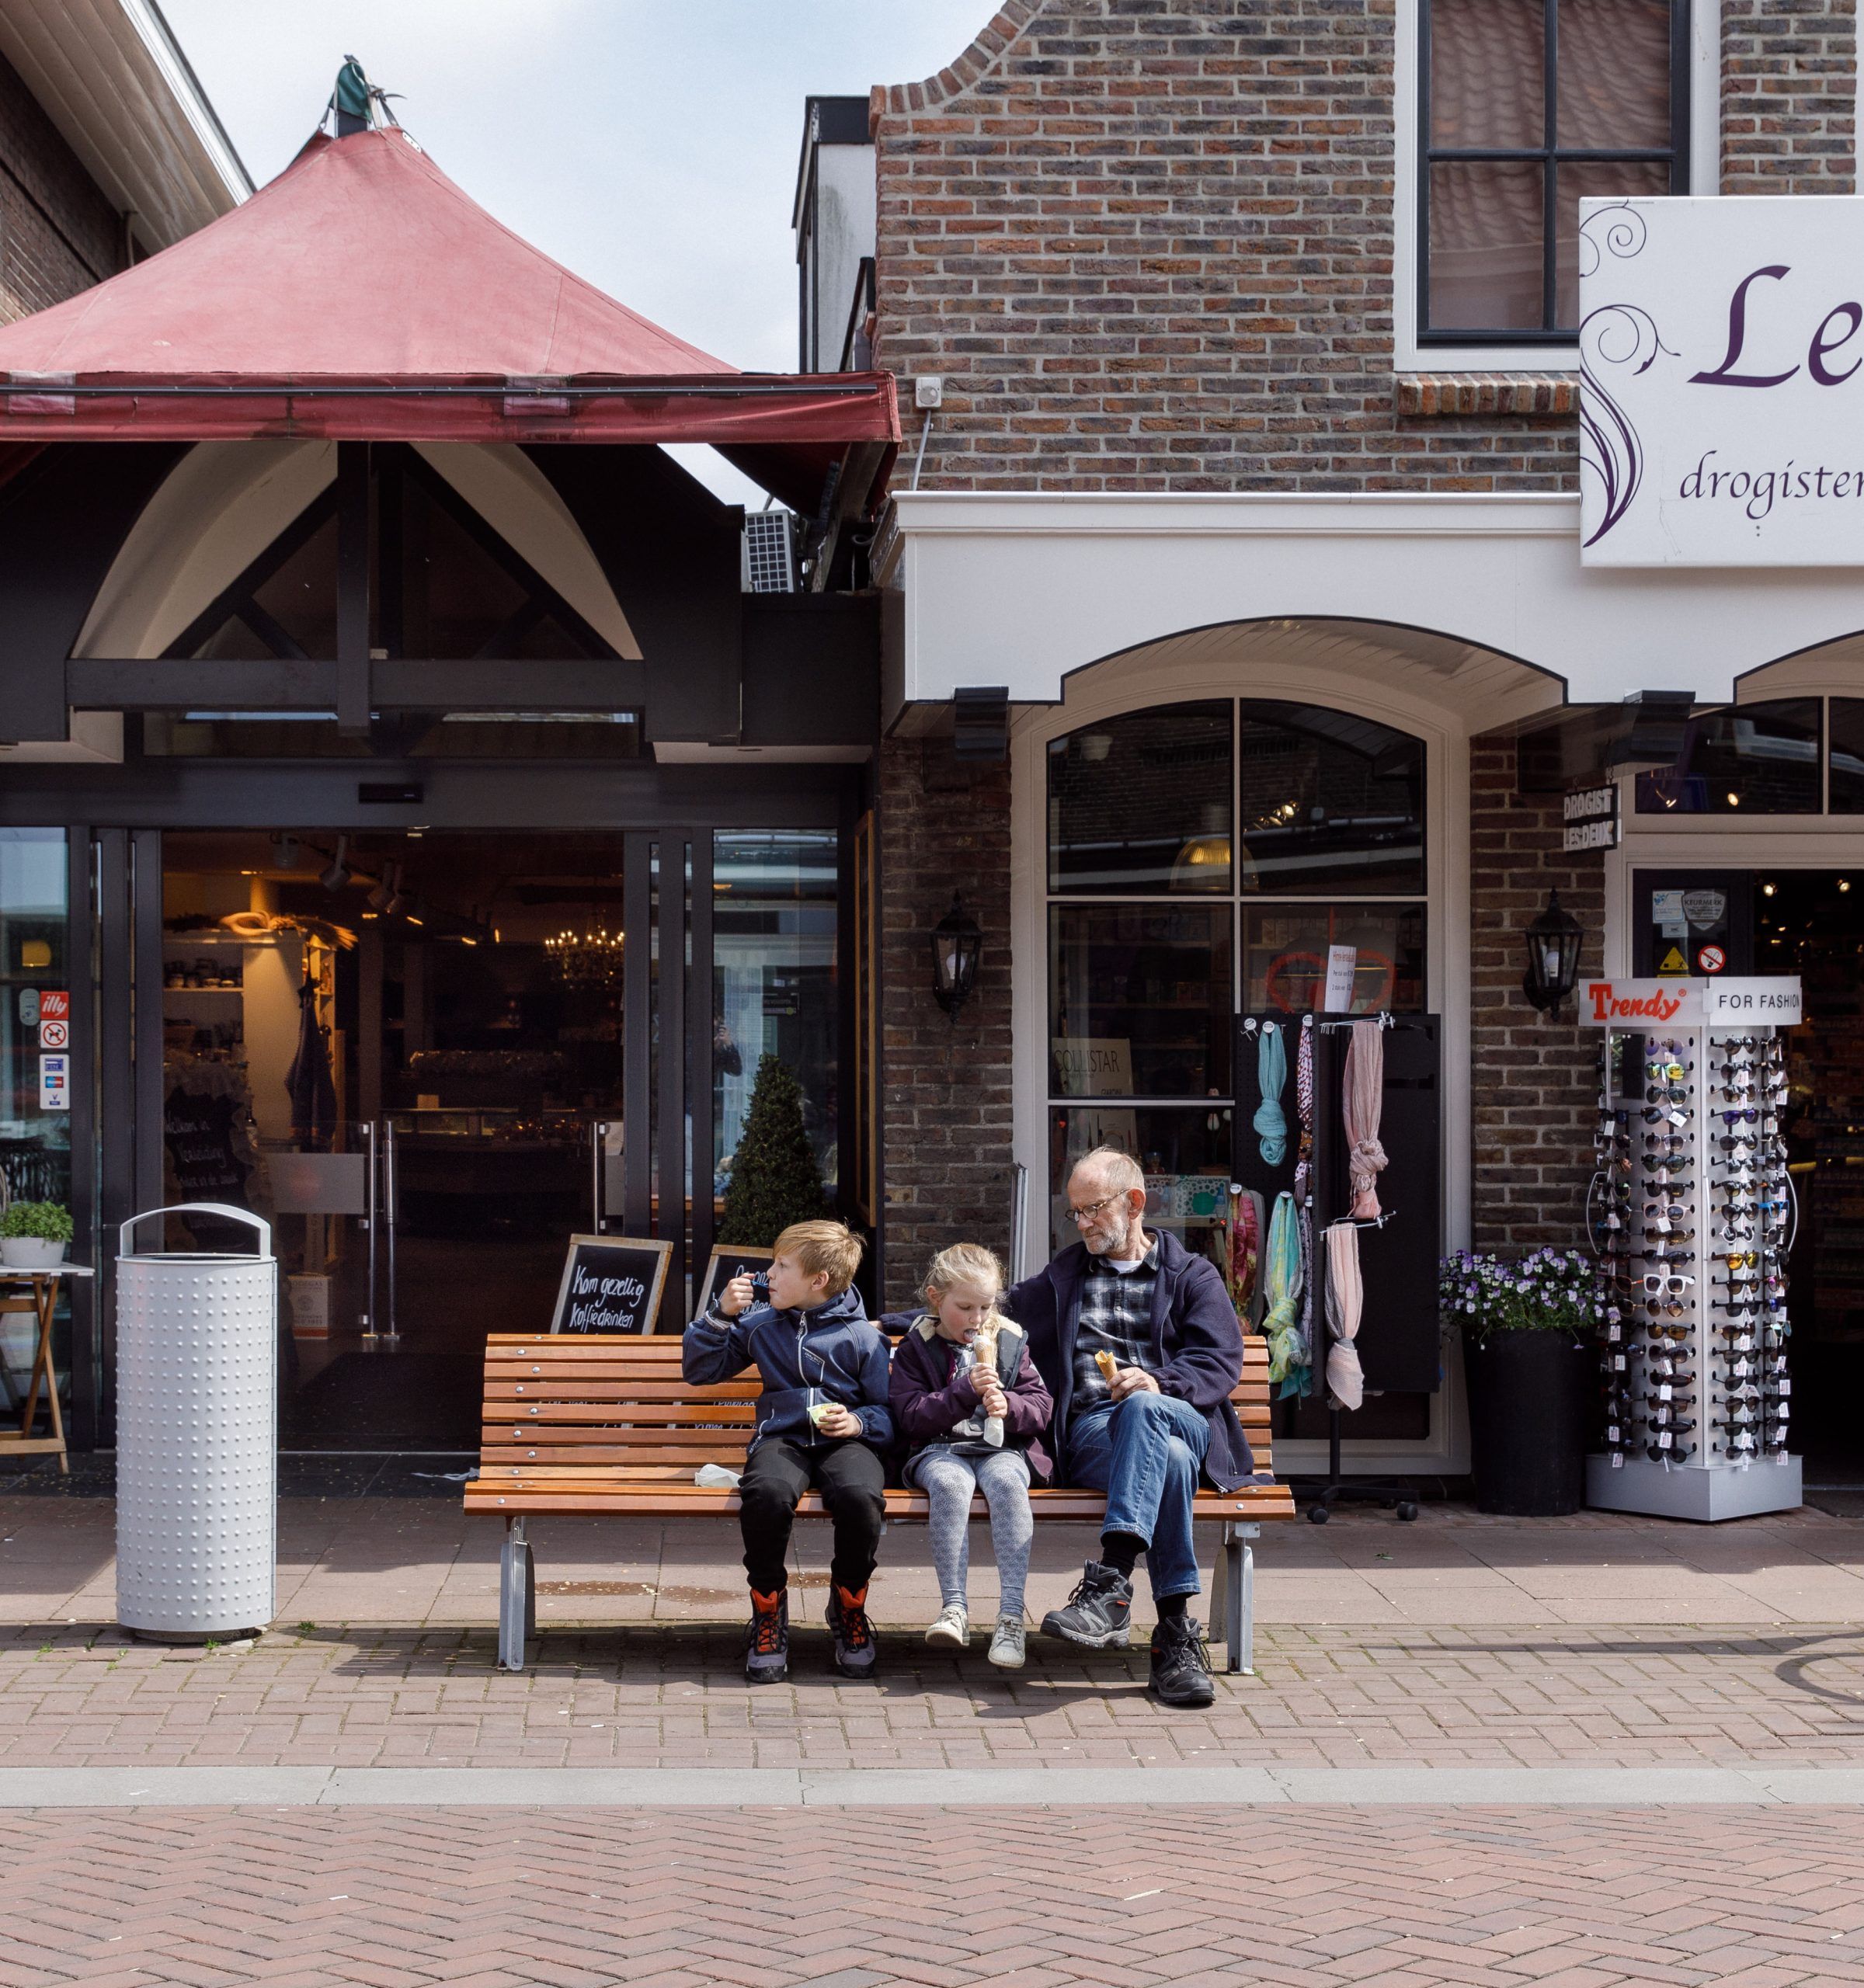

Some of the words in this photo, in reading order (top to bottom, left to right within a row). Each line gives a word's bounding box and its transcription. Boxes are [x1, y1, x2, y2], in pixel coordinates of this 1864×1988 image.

[1686, 265, 1863, 387] Le
[1564, 788, 1612, 820] DROGIST
[1582, 821, 1614, 849] DEUX
[42, 995, 68, 1017] illy
[1719, 995, 1753, 1008] FOR
[1760, 994, 1800, 1008] FASHION
[1054, 1049, 1120, 1072] COLLISTAR
[572, 1265, 599, 1295] Kom
[595, 1277, 645, 1308] gezellig
